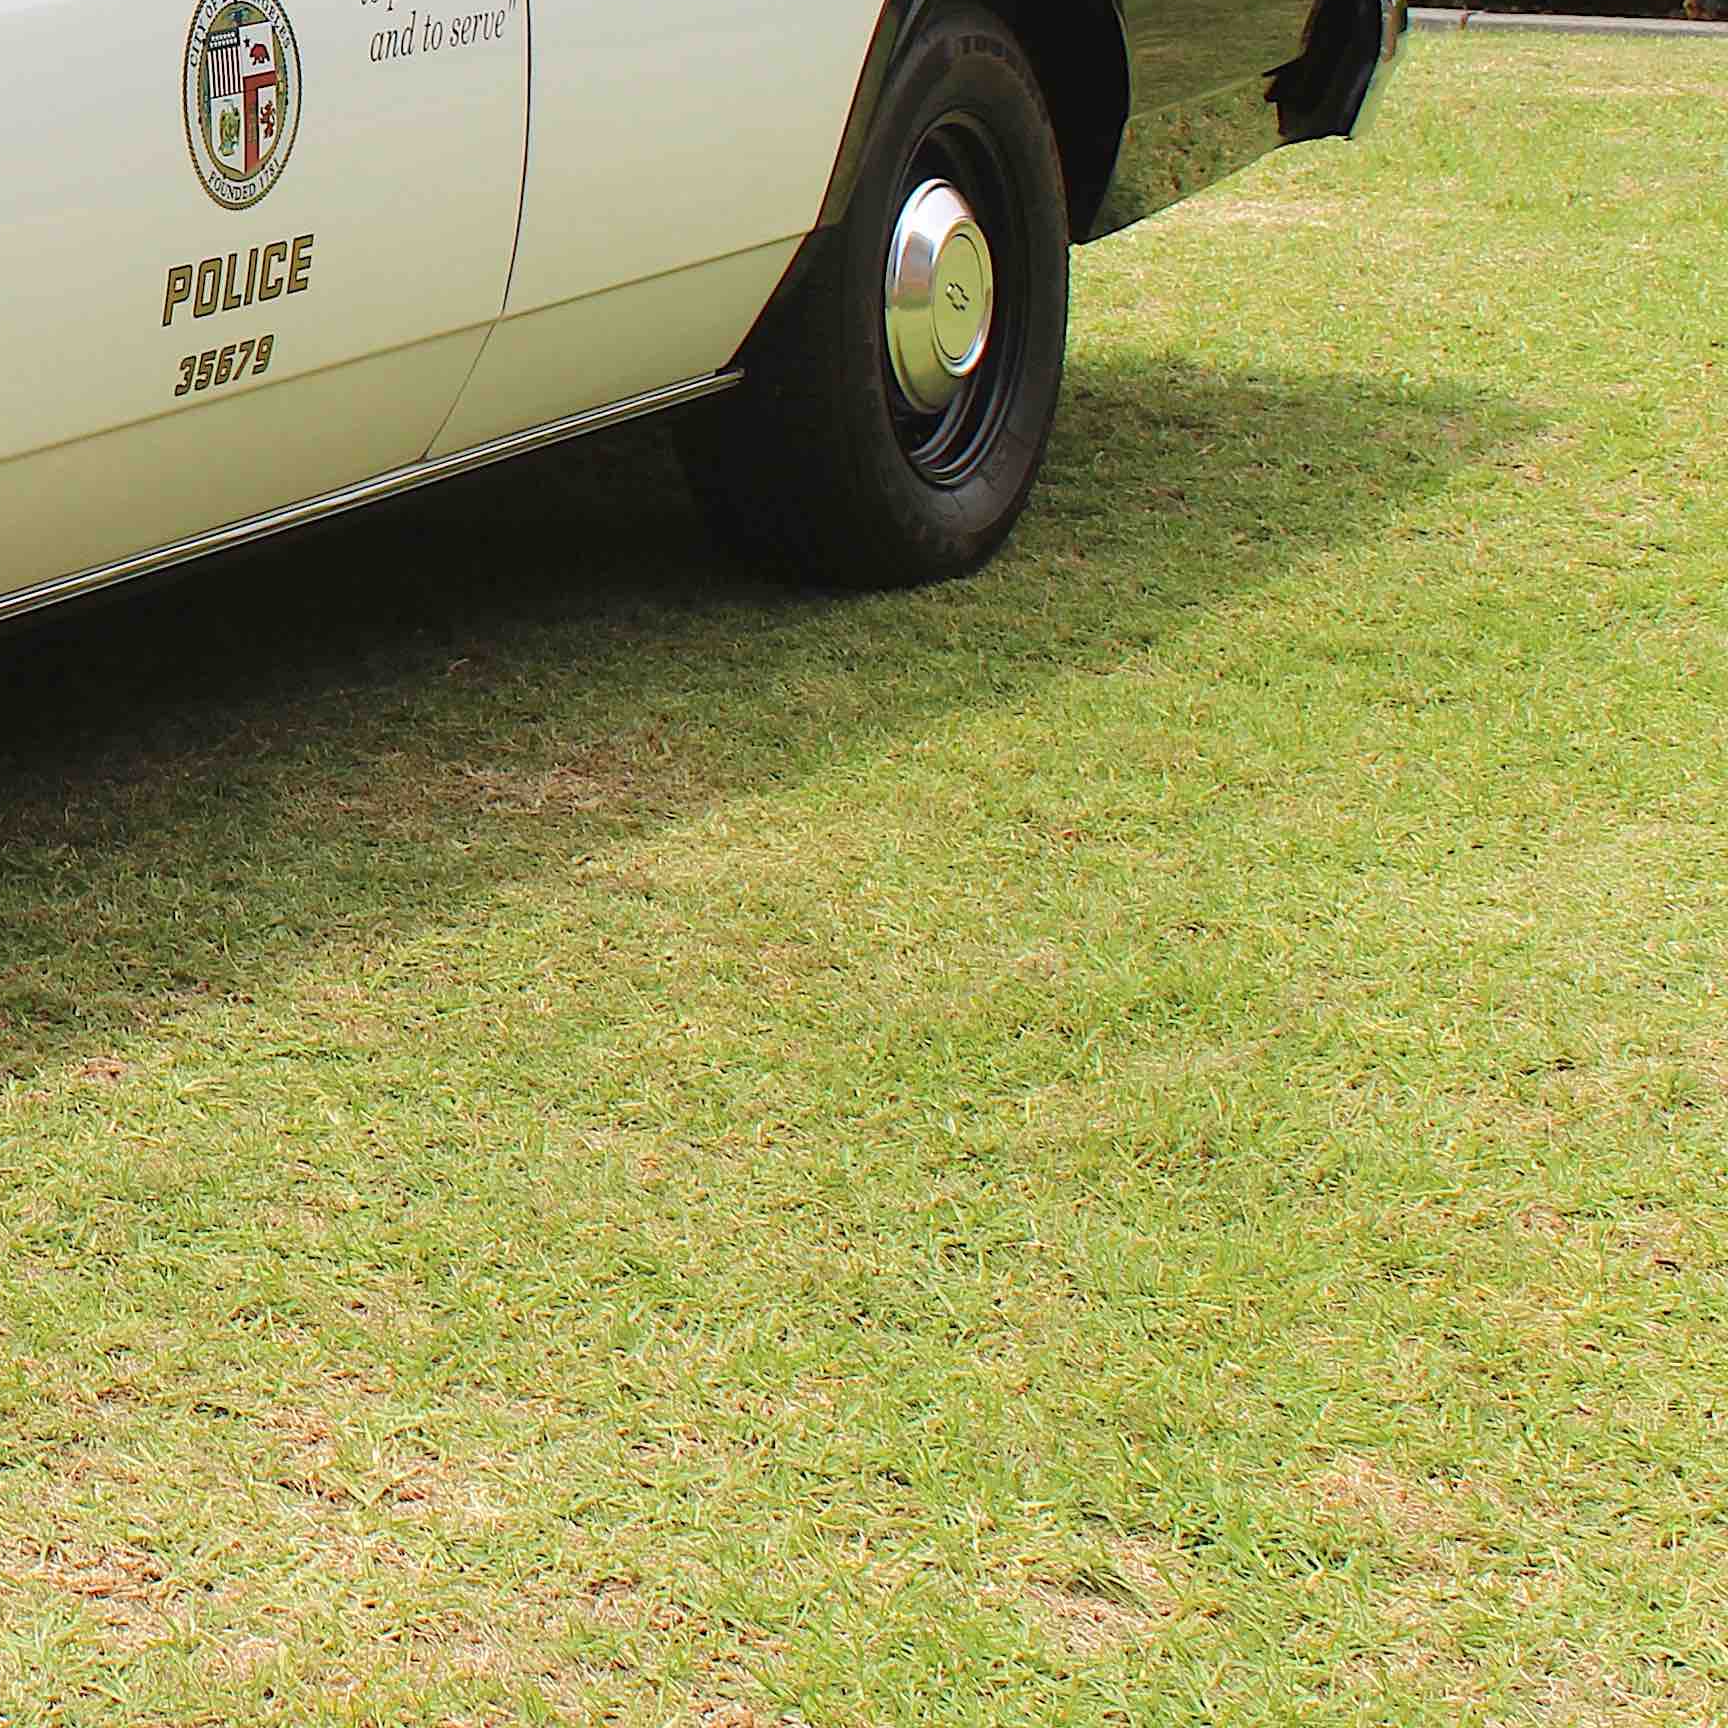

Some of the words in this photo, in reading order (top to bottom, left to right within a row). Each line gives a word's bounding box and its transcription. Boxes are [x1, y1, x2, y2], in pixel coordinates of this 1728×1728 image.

[190, 21, 209, 67] CITY
[206, 0, 219, 18] OF
[369, 10, 417, 63] and
[423, 15, 443, 52] to
[208, 171, 256, 201] FOUNDED
[162, 234, 314, 327] POLICE
[174, 334, 274, 396] 35679
